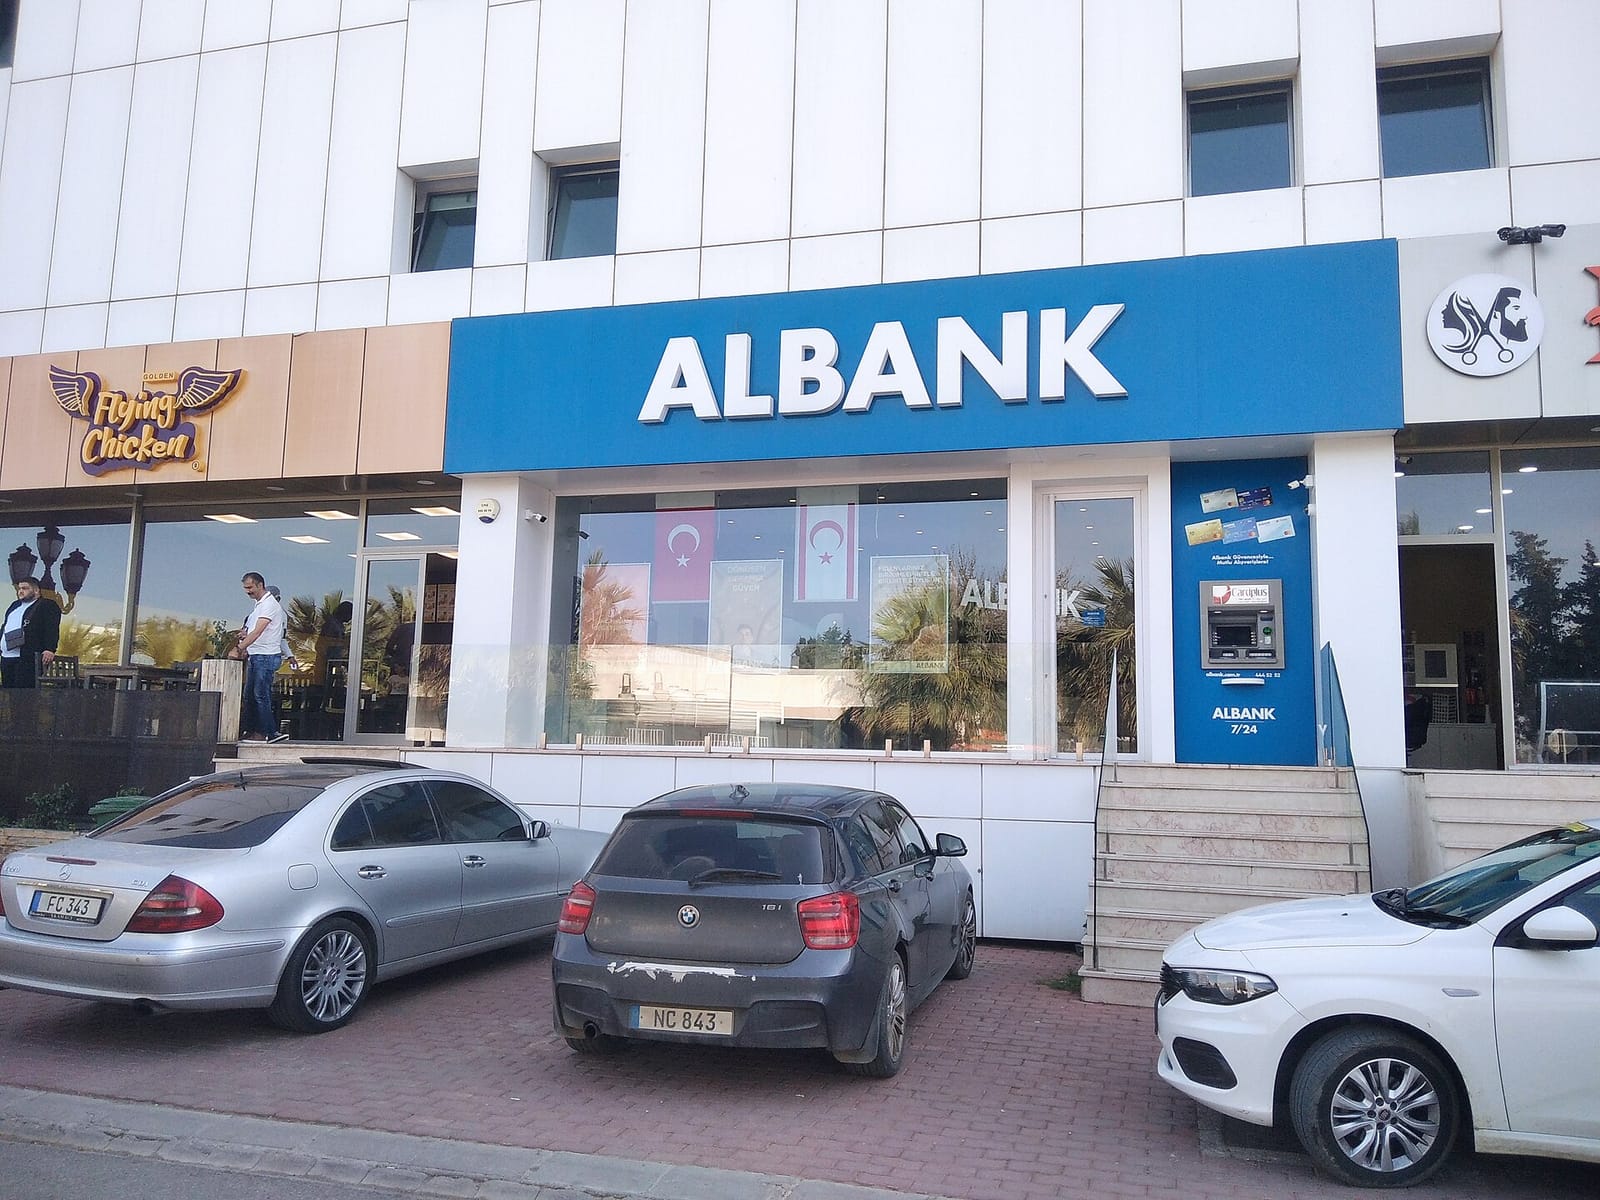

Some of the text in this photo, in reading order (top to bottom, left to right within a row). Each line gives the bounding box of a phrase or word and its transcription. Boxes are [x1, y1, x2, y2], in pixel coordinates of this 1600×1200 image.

[637, 303, 1128, 424] ALBANK
[143, 372, 175, 380] GOLDEN
[94, 391, 177, 431] Flying
[82, 424, 189, 464] Chicken
[1231, 587, 1268, 597] Cardplus
[1212, 707, 1276, 720] ALBANK
[1231, 724, 1258, 735] 7/24
[46, 897, 90, 916] FC 343
[653, 1009, 716, 1031] NC 843
